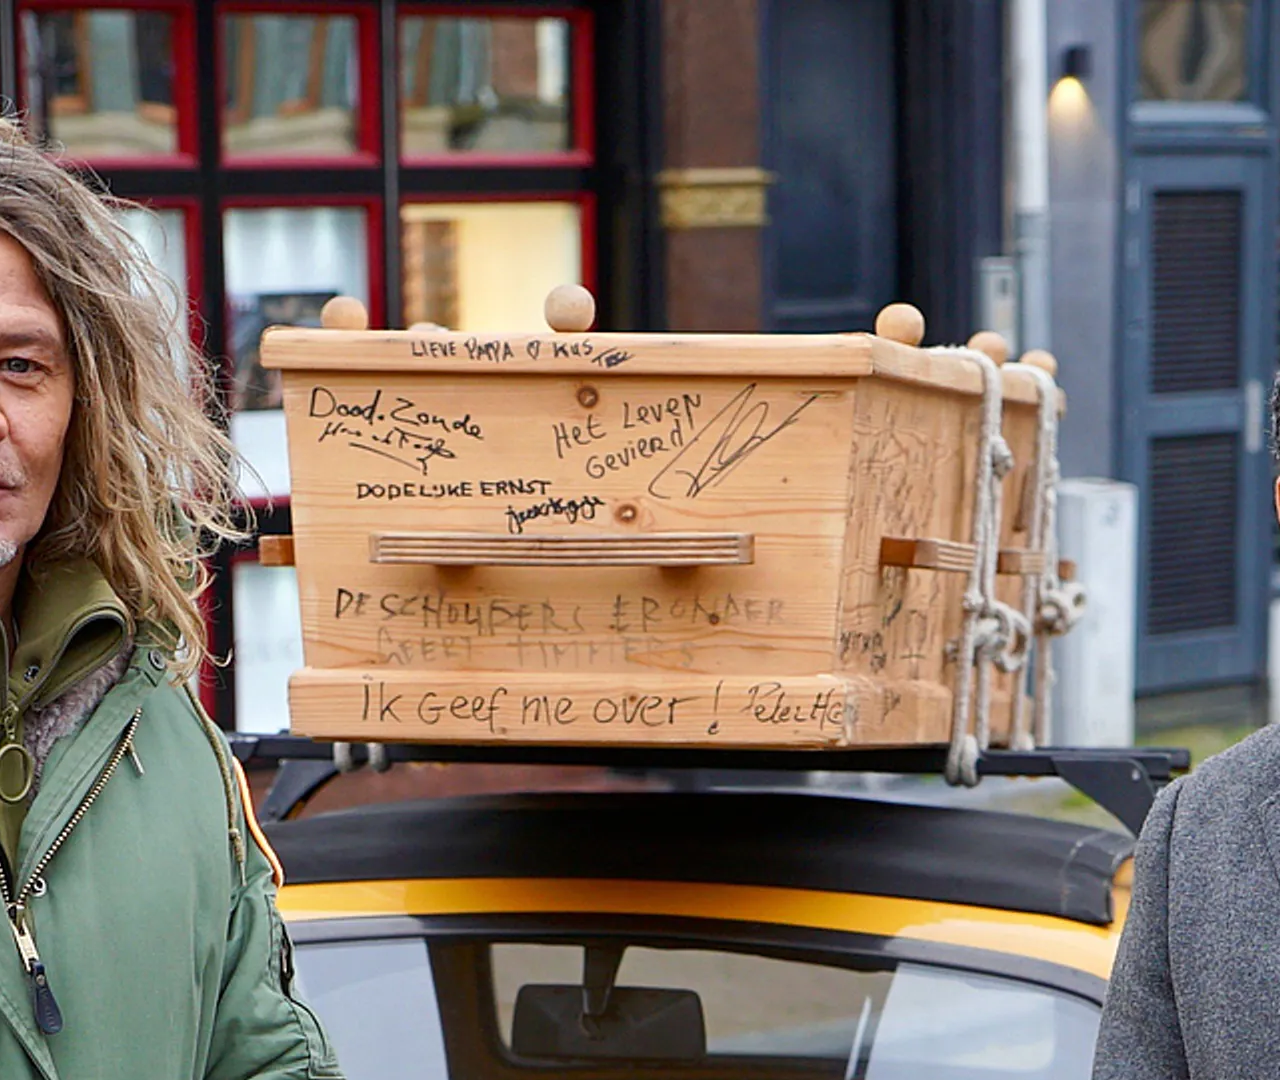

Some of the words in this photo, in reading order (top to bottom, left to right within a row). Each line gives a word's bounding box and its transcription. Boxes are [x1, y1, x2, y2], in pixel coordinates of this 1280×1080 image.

[411, 340, 457, 358] LIEVE
[464, 337, 515, 363] PAPA
[480, 479, 553, 497] ERNST
[521, 695, 579, 726] me
